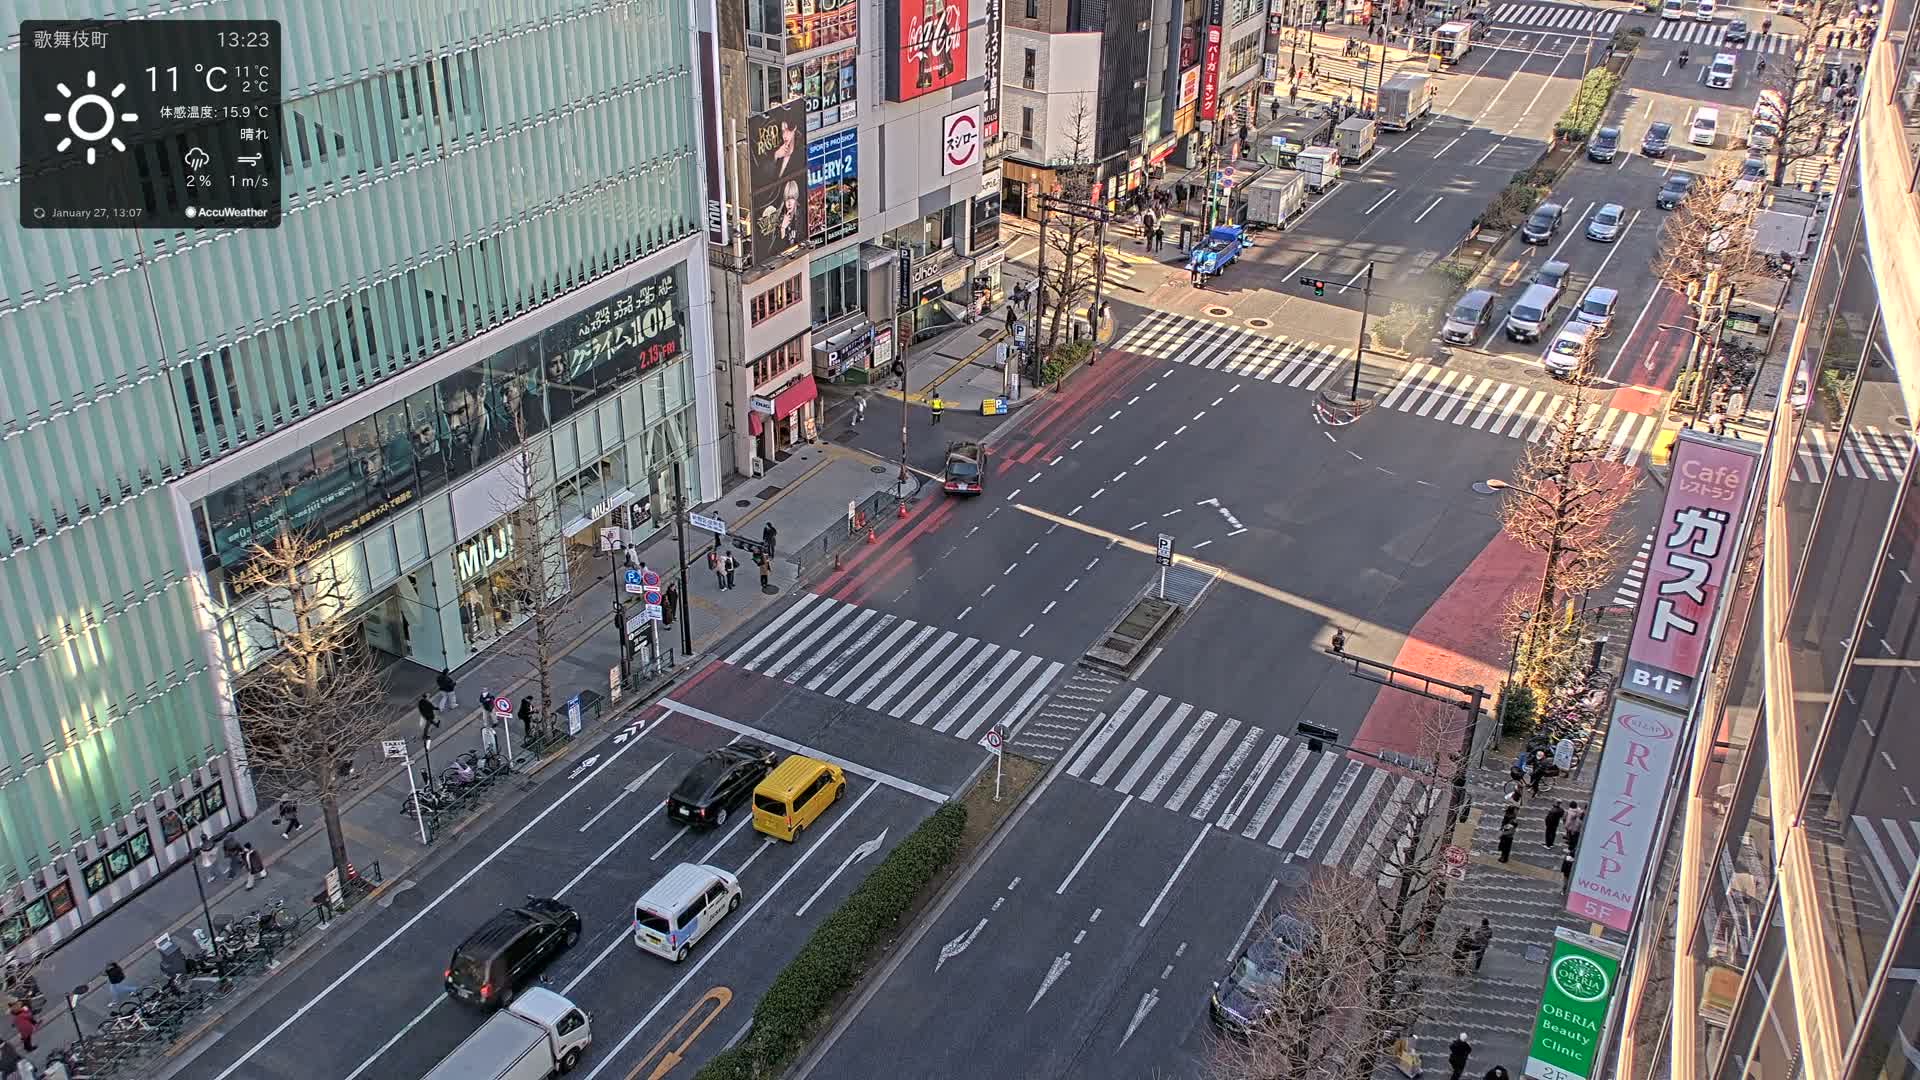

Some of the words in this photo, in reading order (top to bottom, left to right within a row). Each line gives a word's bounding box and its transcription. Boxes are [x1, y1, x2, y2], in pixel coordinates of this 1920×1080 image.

[1204, 45, 1219, 110] バーガーキング
[946, 132, 978, 152] スシロー
[709, 199, 722, 232] MUJI
[616, 295, 633, 308] マーク
[569, 299, 676, 378] クライム101
[1016, 325, 1024, 335] P
[640, 343, 659, 369] 2.13
[661, 340, 676, 358] FRI
[829, 351, 838, 367] P
[1681, 460, 1740, 489] Café
[1679, 479, 1735, 501] レストラン
[591, 496, 613, 520] MUJI
[457, 523, 515, 581] MUJI
[1160, 539, 1168, 549] P
[1649, 507, 1730, 642] ガスト
[1631, 668, 1683, 695] B1F
[1598, 740, 1651, 880] RIZAP
[1577, 878, 1632, 904] WOMAN
[1583, 901, 1613, 921] 5F
[1559, 969, 1600, 990] OBERIA
[1543, 1003, 1598, 1032] OBERIA
[1542, 1019, 1591, 1046] Beauty
[1542, 1038, 1583, 1060] Clinic
